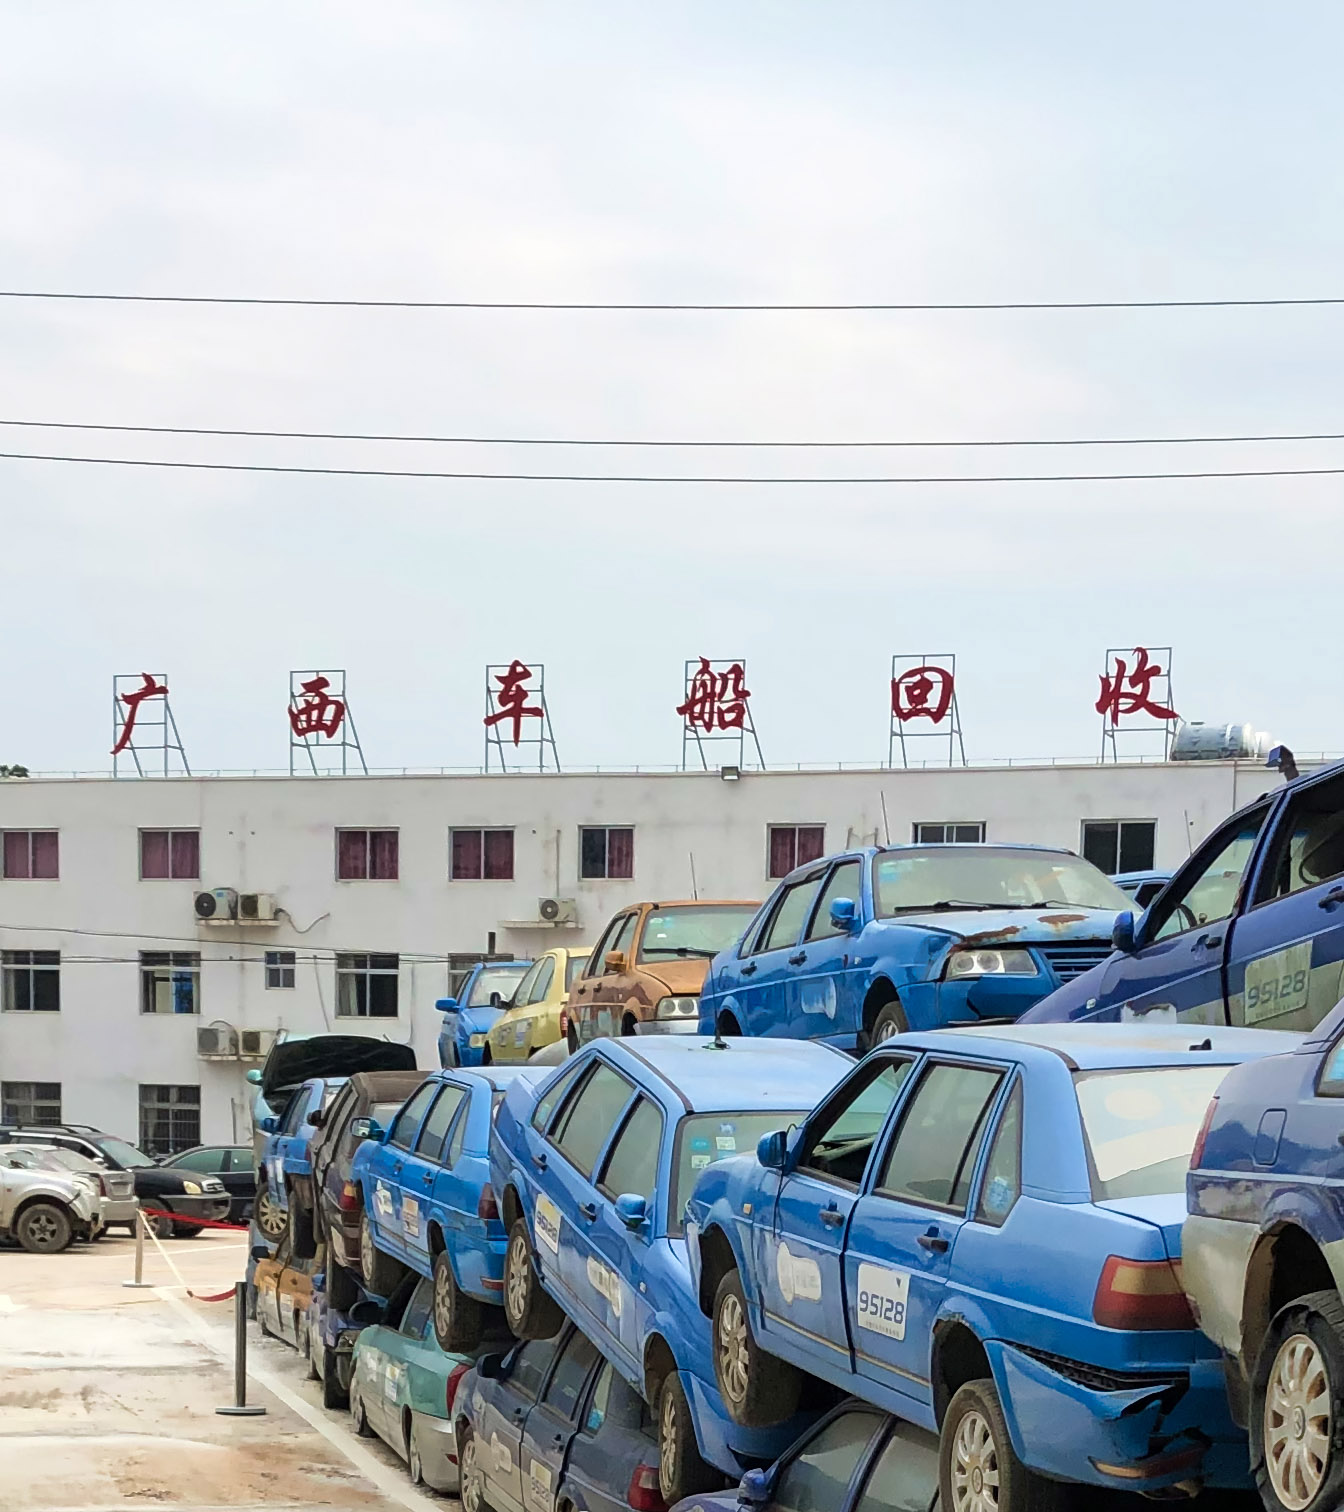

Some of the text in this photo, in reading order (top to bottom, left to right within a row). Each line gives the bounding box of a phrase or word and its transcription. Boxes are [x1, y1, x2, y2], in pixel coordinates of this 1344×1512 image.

[111, 648, 1178, 755] 广西车船回收
[1247, 969, 1306, 1009] 95128
[859, 1290, 905, 1325] 95128
